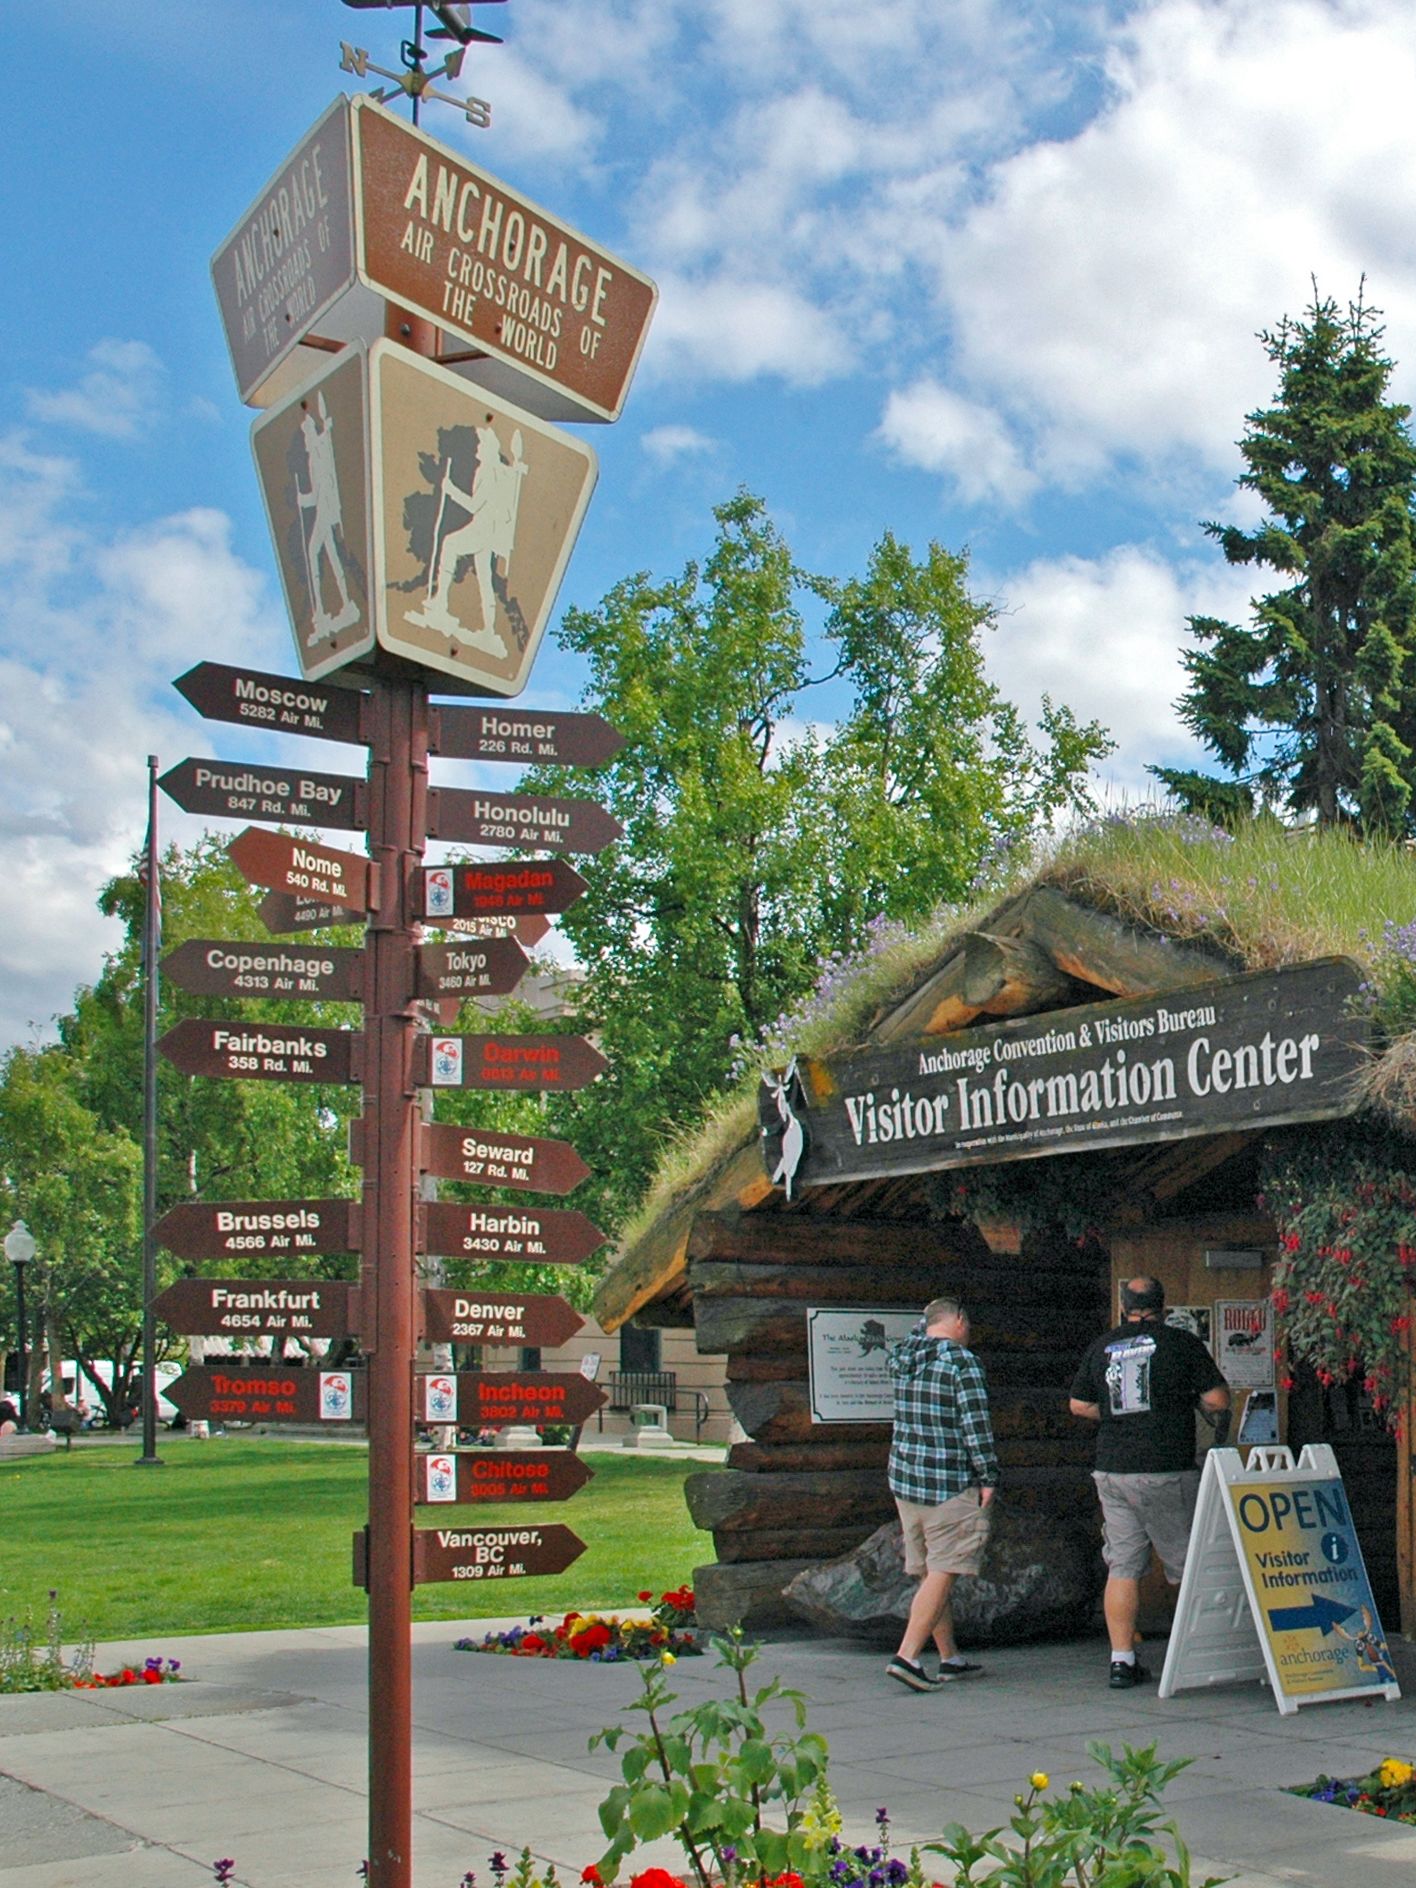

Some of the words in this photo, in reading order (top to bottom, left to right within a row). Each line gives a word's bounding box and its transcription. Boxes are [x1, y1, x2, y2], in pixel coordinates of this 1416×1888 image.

[234, 144, 328, 307] ANCHORAGE
[404, 152, 613, 326] ANCHORAGE
[258, 238, 312, 323] CROSSROADS
[317, 215, 330, 253] OF
[400, 220, 434, 264] AIR
[448, 247, 563, 337] CROSSROADS
[580, 325, 602, 359] OF
[443, 280, 476, 326] THE
[501, 314, 557, 370] WORLD
[235, 678, 328, 713] Moscow
[239, 703, 276, 721] 5282
[280, 711, 299, 725] Air
[304, 715, 324, 729] Mi.
[481, 716, 556, 739] Homer
[478, 739, 506, 753] 226
[511, 742, 533, 755] Rd.
[538, 743, 558, 756] Mi.
[195, 768, 290, 796] Prudhoe
[300, 780, 342, 806] Bay
[228, 796, 257, 810] 847
[262, 801, 285, 814] Rd.
[290, 803, 311, 817] Mi.
[474, 800, 570, 827] Honolulu
[480, 824, 515, 839] 2780
[520, 828, 539, 841] Air
[544, 830, 564, 843] Mi.
[292, 847, 342, 878] Nome
[286, 871, 309, 887] 540
[311, 877, 329, 893] Rd.
[332, 882, 348, 897] Mi.
[465, 870, 554, 893] Magadan
[453, 919, 476, 933] 2015
[479, 926, 493, 937] Air
[207, 950, 334, 977] Copenhage
[446, 951, 487, 972] Tokyo
[233, 975, 269, 989] 4313
[274, 977, 294, 990] Air
[299, 978, 320, 992] Mi.
[464, 975, 477, 987] Air
[213, 1030, 327, 1058] Fairbanks
[918, 1048, 991, 1075] Anchorage
[994, 1029, 1076, 1062] Convention
[1079, 1023, 1092, 1048] &
[1094, 1016, 1155, 1045] Visitors
[1157, 1006, 1217, 1034] Bureau
[483, 1042, 561, 1063] Darwin
[228, 1055, 258, 1070] 358
[263, 1058, 287, 1072] Rd.
[293, 1060, 313, 1074] Mi.
[845, 1088, 949, 1146] Visitor
[957, 1049, 1177, 1131] Information
[1187, 1031, 1320, 1097] Center
[462, 1138, 534, 1165] Seward
[463, 1160, 485, 1174] 127
[487, 1164, 508, 1178] Rd.
[511, 1167, 530, 1181] Mi.
[216, 1209, 320, 1232] Brussels
[470, 1213, 540, 1235] Harbin
[225, 1236, 266, 1249] 4566
[270, 1235, 291, 1248] Air
[295, 1233, 317, 1247] Mi.
[463, 1237, 499, 1251] 3430
[504, 1240, 523, 1253] Air
[527, 1241, 547, 1254] Mi.
[212, 1289, 320, 1309] Frankfurt
[455, 1299, 525, 1320] Denver
[221, 1315, 261, 1327] 4654
[266, 1315, 287, 1327] Air
[291, 1315, 313, 1328] Mi.
[452, 1323, 484, 1336] 2367
[487, 1324, 505, 1337] Air
[508, 1325, 526, 1338] Mi.
[211, 1374, 297, 1396] Tromso
[478, 1382, 566, 1401] Incheon
[252, 1402, 272, 1414] Air
[522, 1407, 540, 1418] Air
[544, 1406, 564, 1418] Mi.
[472, 1460, 549, 1479] Chitose
[510, 1483, 527, 1495] Air
[1239, 1488, 1347, 1533] OPEN
[438, 1531, 542, 1548] Vancouver,
[476, 1547, 504, 1563] BC
[1255, 1551, 1311, 1569] Visitor
[452, 1566, 483, 1578] 1309
[488, 1565, 505, 1577] Air
[509, 1563, 526, 1575] Mi.
[1261, 1567, 1359, 1589] Information
[1280, 1647, 1349, 1666] anchorage
